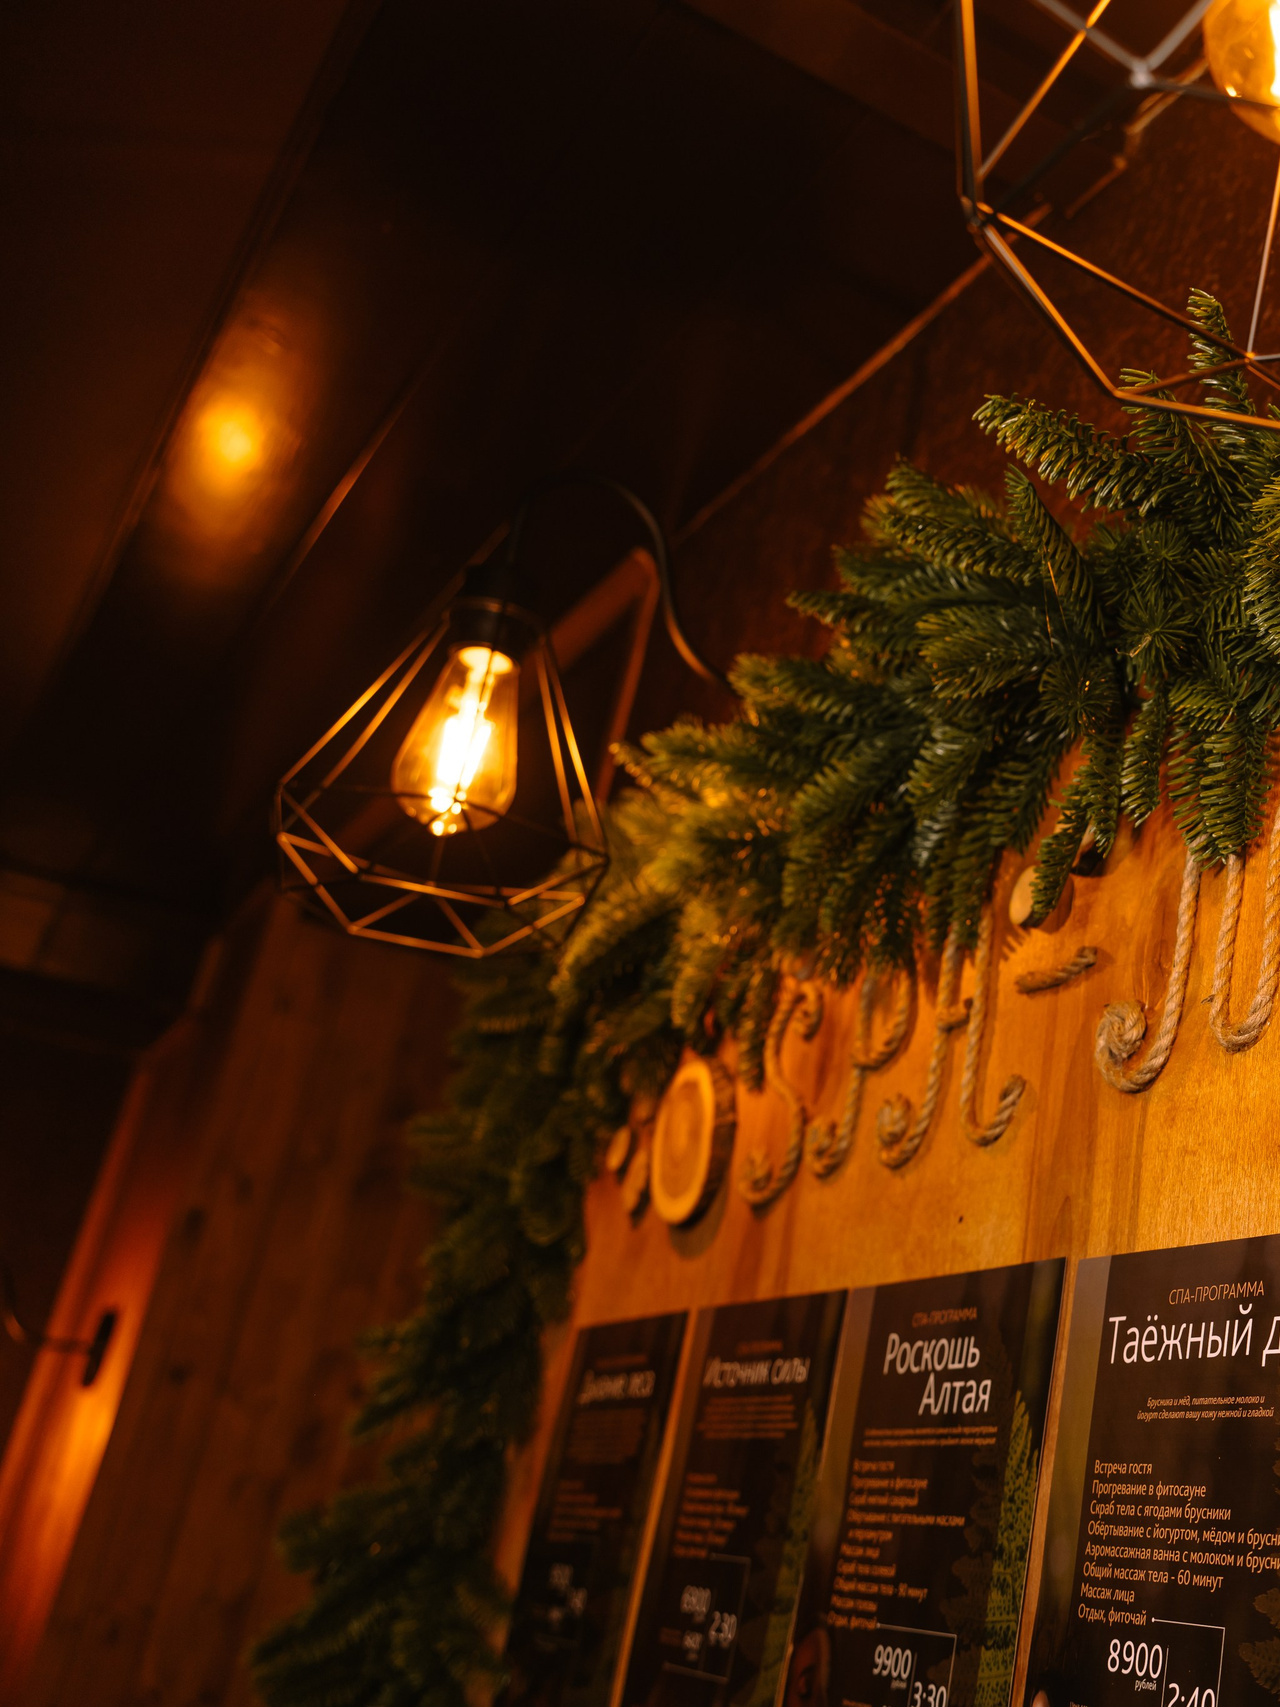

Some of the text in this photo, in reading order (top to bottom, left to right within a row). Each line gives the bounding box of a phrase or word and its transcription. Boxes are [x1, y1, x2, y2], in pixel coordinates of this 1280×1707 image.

[1168, 1280, 1265, 1305] СПА-ПРОГРАММА
[912, 1307, 978, 1328] СПА-ПРОГРАММА
[1108, 1303, 1253, 1364] Таёжный
[882, 1333, 981, 1375] Роскошь
[917, 1372, 992, 1416] Алтая
[1147, 1397, 1173, 1409] Брусника
[1173, 1398, 1178, 1406] и
[1191, 1396, 1235, 1405] питательное
[1235, 1396, 1260, 1405] молоко
[1260, 1396, 1265, 1404] и
[1137, 1407, 1275, 1422] йогурт сделают вашу кожу нежной и гладкой
[1094, 1459, 1153, 1478] Встреча гостя
[1092, 1480, 1207, 1501] Прогревание в фитосауне
[1090, 1500, 1231, 1523] Скраб тела с ягодами брусники
[1087, 1520, 1144, 1539] Обёртывание
[1146, 1527, 1152, 1537] с
[1153, 1523, 1200, 1544] йогуртом,
[1202, 1528, 1235, 1549] мёдом
[1237, 1534, 1244, 1544] и
[1085, 1541, 1151, 1563] Аэромассажная
[1152, 1549, 1180, 1563] ванна
[1182, 1552, 1188, 1563] с
[1190, 1552, 1234, 1566] молоком
[1236, 1556, 1243, 1567] и
[1083, 1561, 1112, 1580] Общий
[1113, 1567, 1146, 1581] массаж
[1148, 1571, 1168, 1583] тела
[1177, 1569, 1191, 1585] 60
[1192, 1574, 1224, 1592] минут
[1080, 1583, 1135, 1605] Массаж лица
[1078, 1603, 1147, 1626] Отдых, фиточай
[872, 1644, 912, 1680] 9900
[1107, 1638, 1163, 1679] 8900
[1134, 1678, 1157, 1692] рублей
